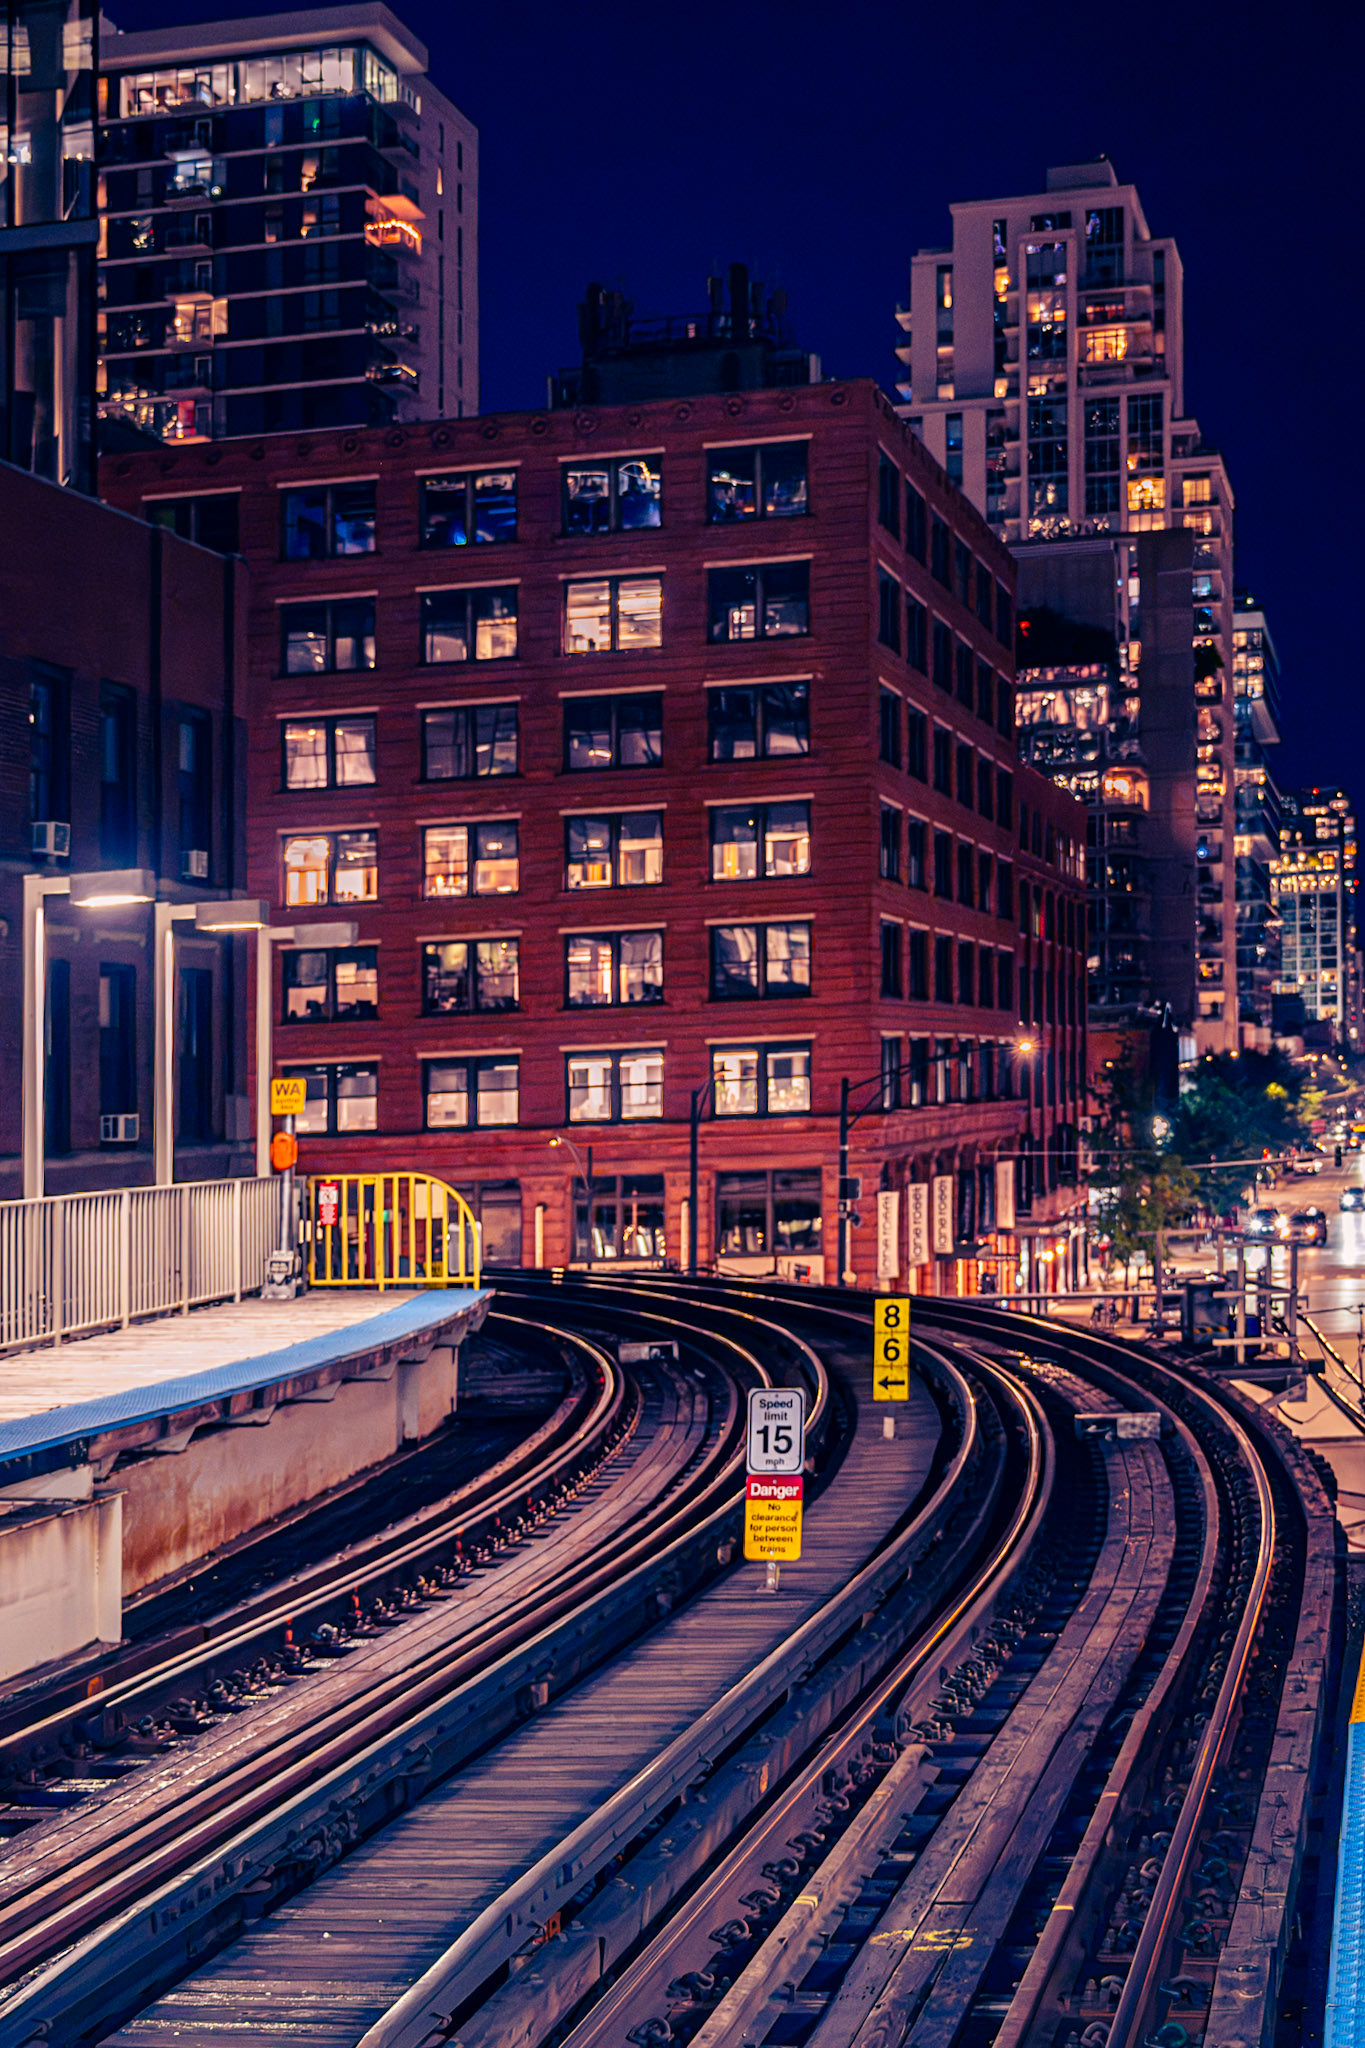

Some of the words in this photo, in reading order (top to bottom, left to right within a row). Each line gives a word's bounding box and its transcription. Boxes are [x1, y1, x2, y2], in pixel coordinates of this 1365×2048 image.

[275, 1083, 301, 1096] WA
[884, 1305, 900, 1328] 8
[884, 1338, 900, 1361] 6
[759, 1398, 793, 1410] Speed
[764, 1411, 788, 1421] limit
[756, 1425, 793, 1454] 15
[765, 1458, 785, 1467] mph
[750, 1482, 800, 1500] Danger
[768, 1503, 781, 1511] No
[751, 1513, 798, 1522] clearance
[750, 1523, 763, 1532] for
[765, 1525, 798, 1533] person
[753, 1534, 793, 1543] between
[760, 1545, 786, 1553] trains
